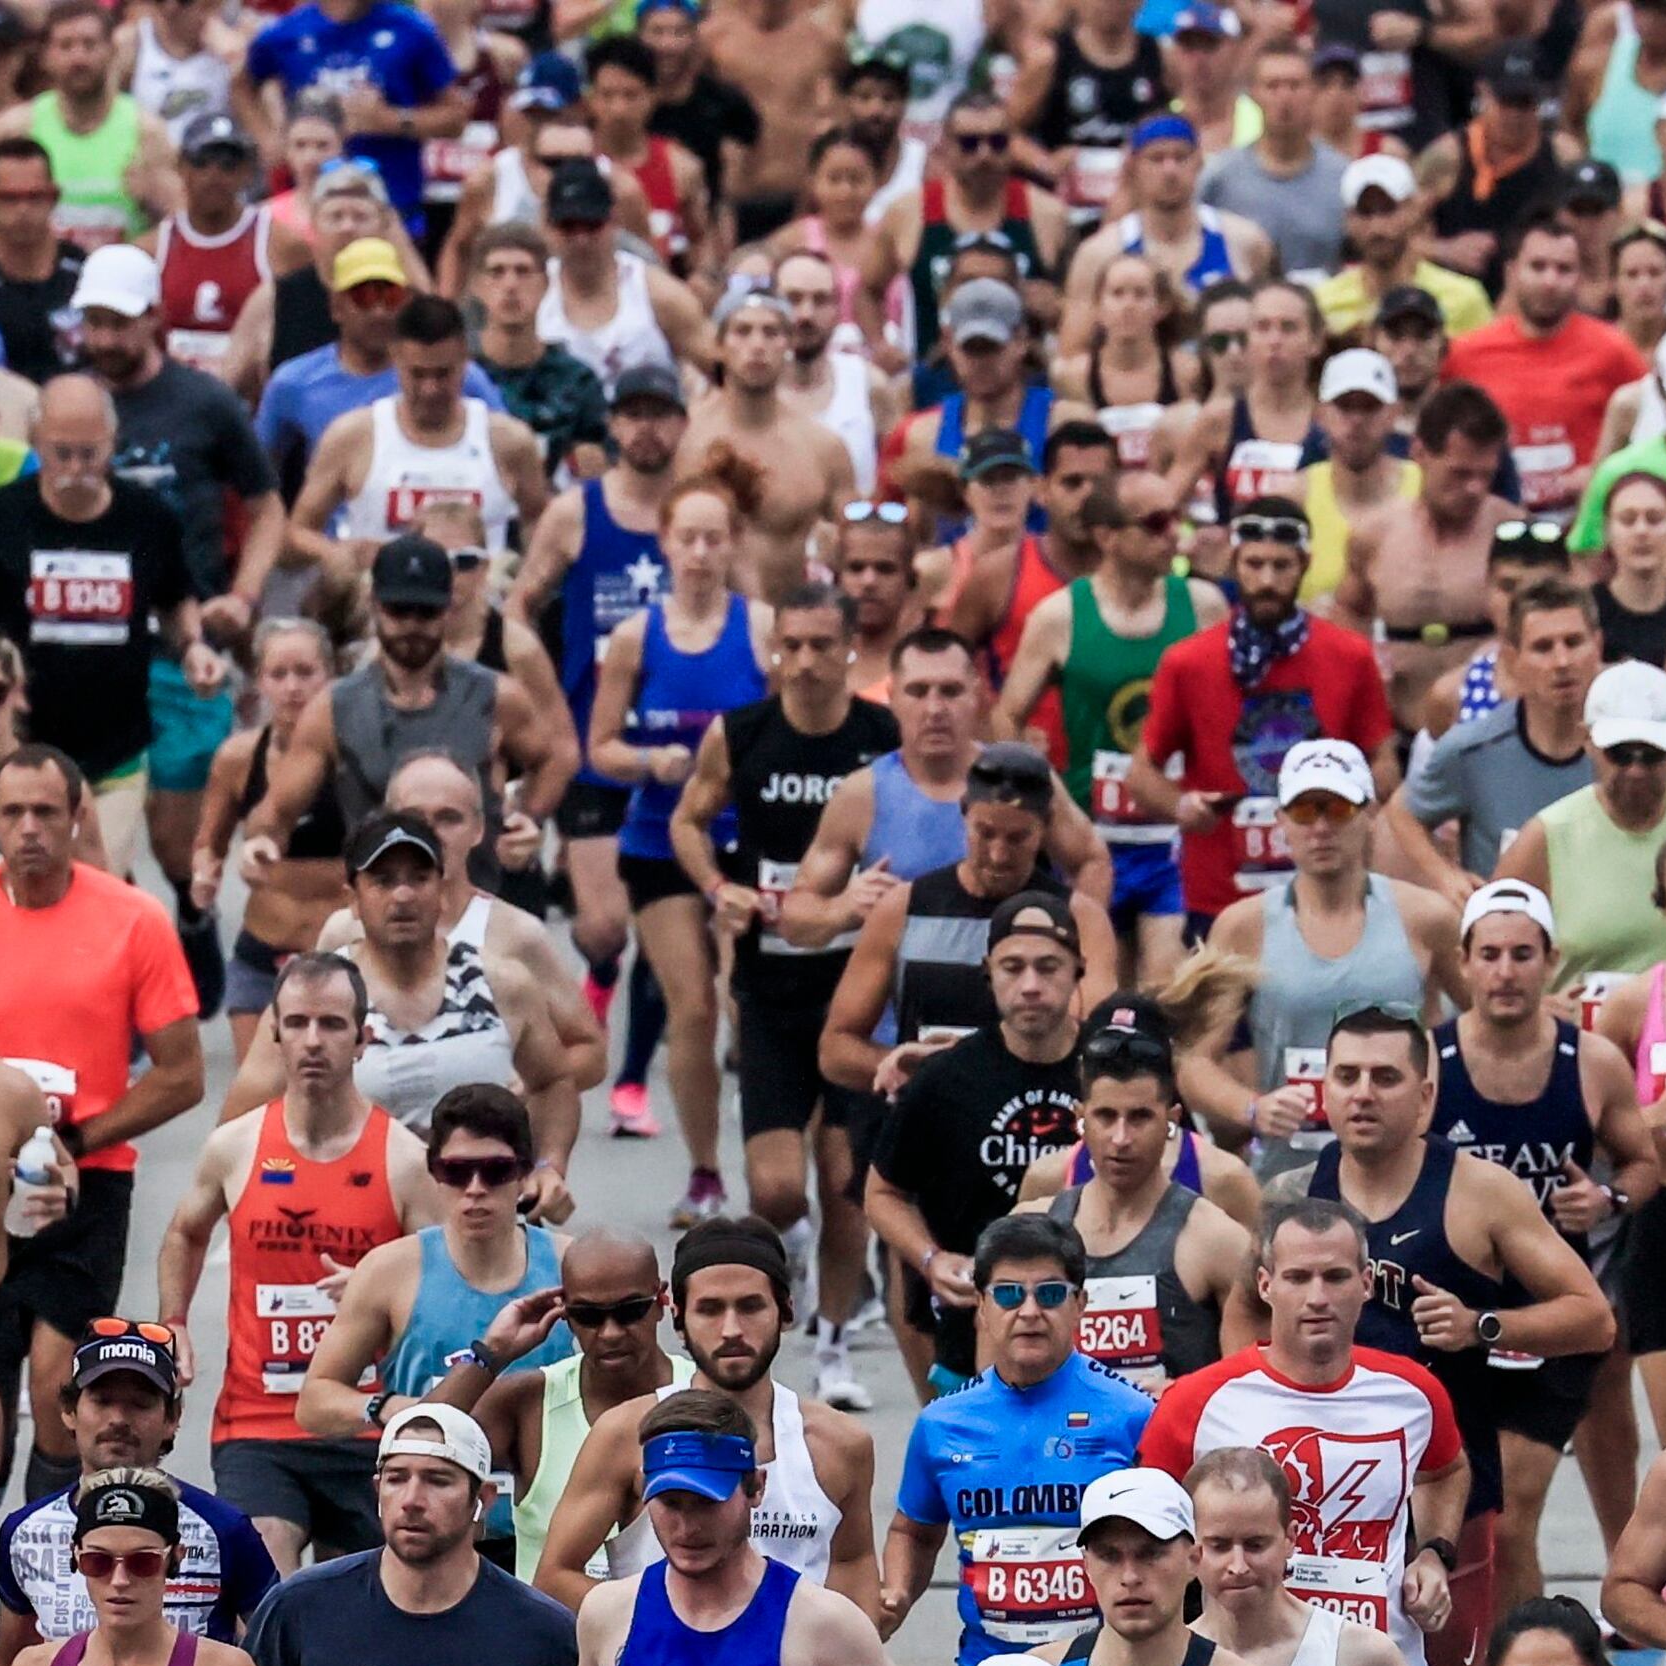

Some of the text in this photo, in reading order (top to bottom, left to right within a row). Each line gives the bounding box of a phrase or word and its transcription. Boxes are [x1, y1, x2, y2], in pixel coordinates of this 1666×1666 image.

[249, 1221, 377, 1244] PHOENIX
[270, 1322, 290, 1354] B
[1080, 1317, 1146, 1349] 5264
[100, 1342, 156, 1367] momia
[958, 1483, 1087, 1519] COLOMBI
[753, 1525, 817, 1539] ARATHON
[988, 1567, 1083, 1602] B 6346
